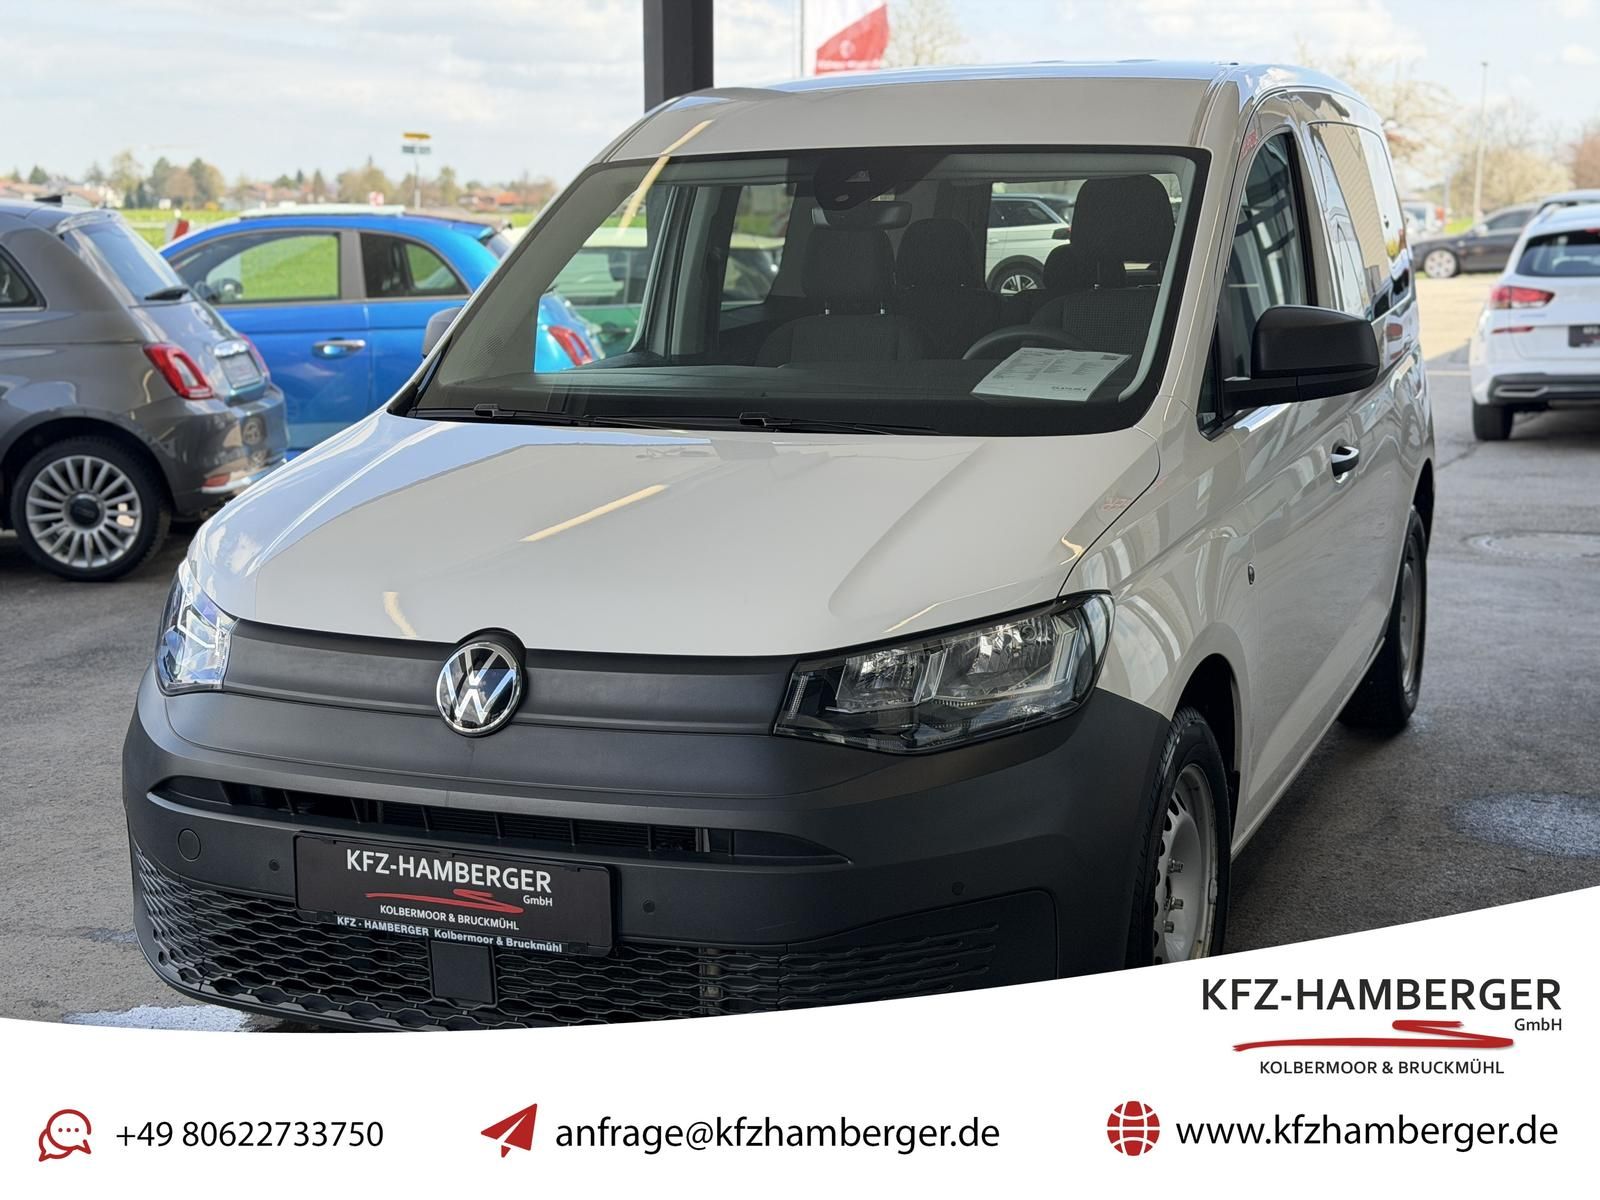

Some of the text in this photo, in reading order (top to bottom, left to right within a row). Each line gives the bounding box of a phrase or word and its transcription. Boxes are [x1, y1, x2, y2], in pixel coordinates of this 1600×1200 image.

[346, 848, 552, 893] KFZ-HAMBERGER
[522, 894, 553, 907] GmbH
[380, 904, 520, 931] KOLBERMOOR & BRUCKMÜHL
[337, 916, 357, 928] KFZ
[364, 919, 430, 937] HAMBERGER
[434, 928, 494, 945] Kolbermoor
[496, 936, 504, 946] &
[506, 937, 563, 954] Bruckmühl
